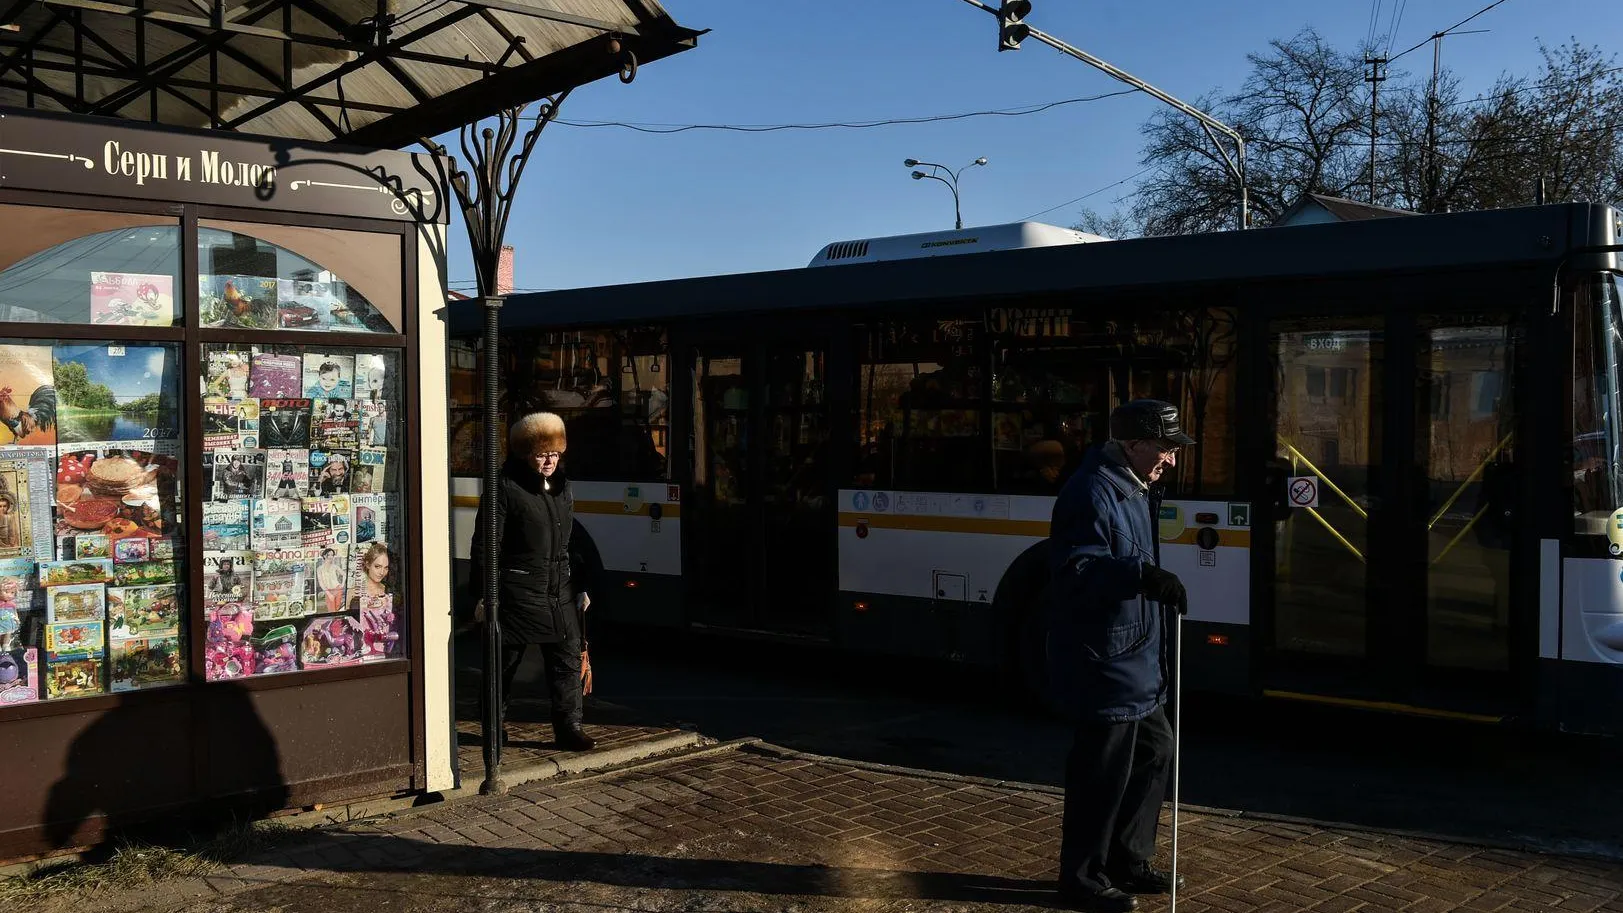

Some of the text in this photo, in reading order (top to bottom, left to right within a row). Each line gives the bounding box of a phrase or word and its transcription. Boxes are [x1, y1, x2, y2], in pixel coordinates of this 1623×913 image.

[104, 140, 276, 188] Серп и Молот
[259, 281, 275, 289] 2017
[1310, 338, 1343, 350] ВХОД
[142, 427, 173, 438] 2017
